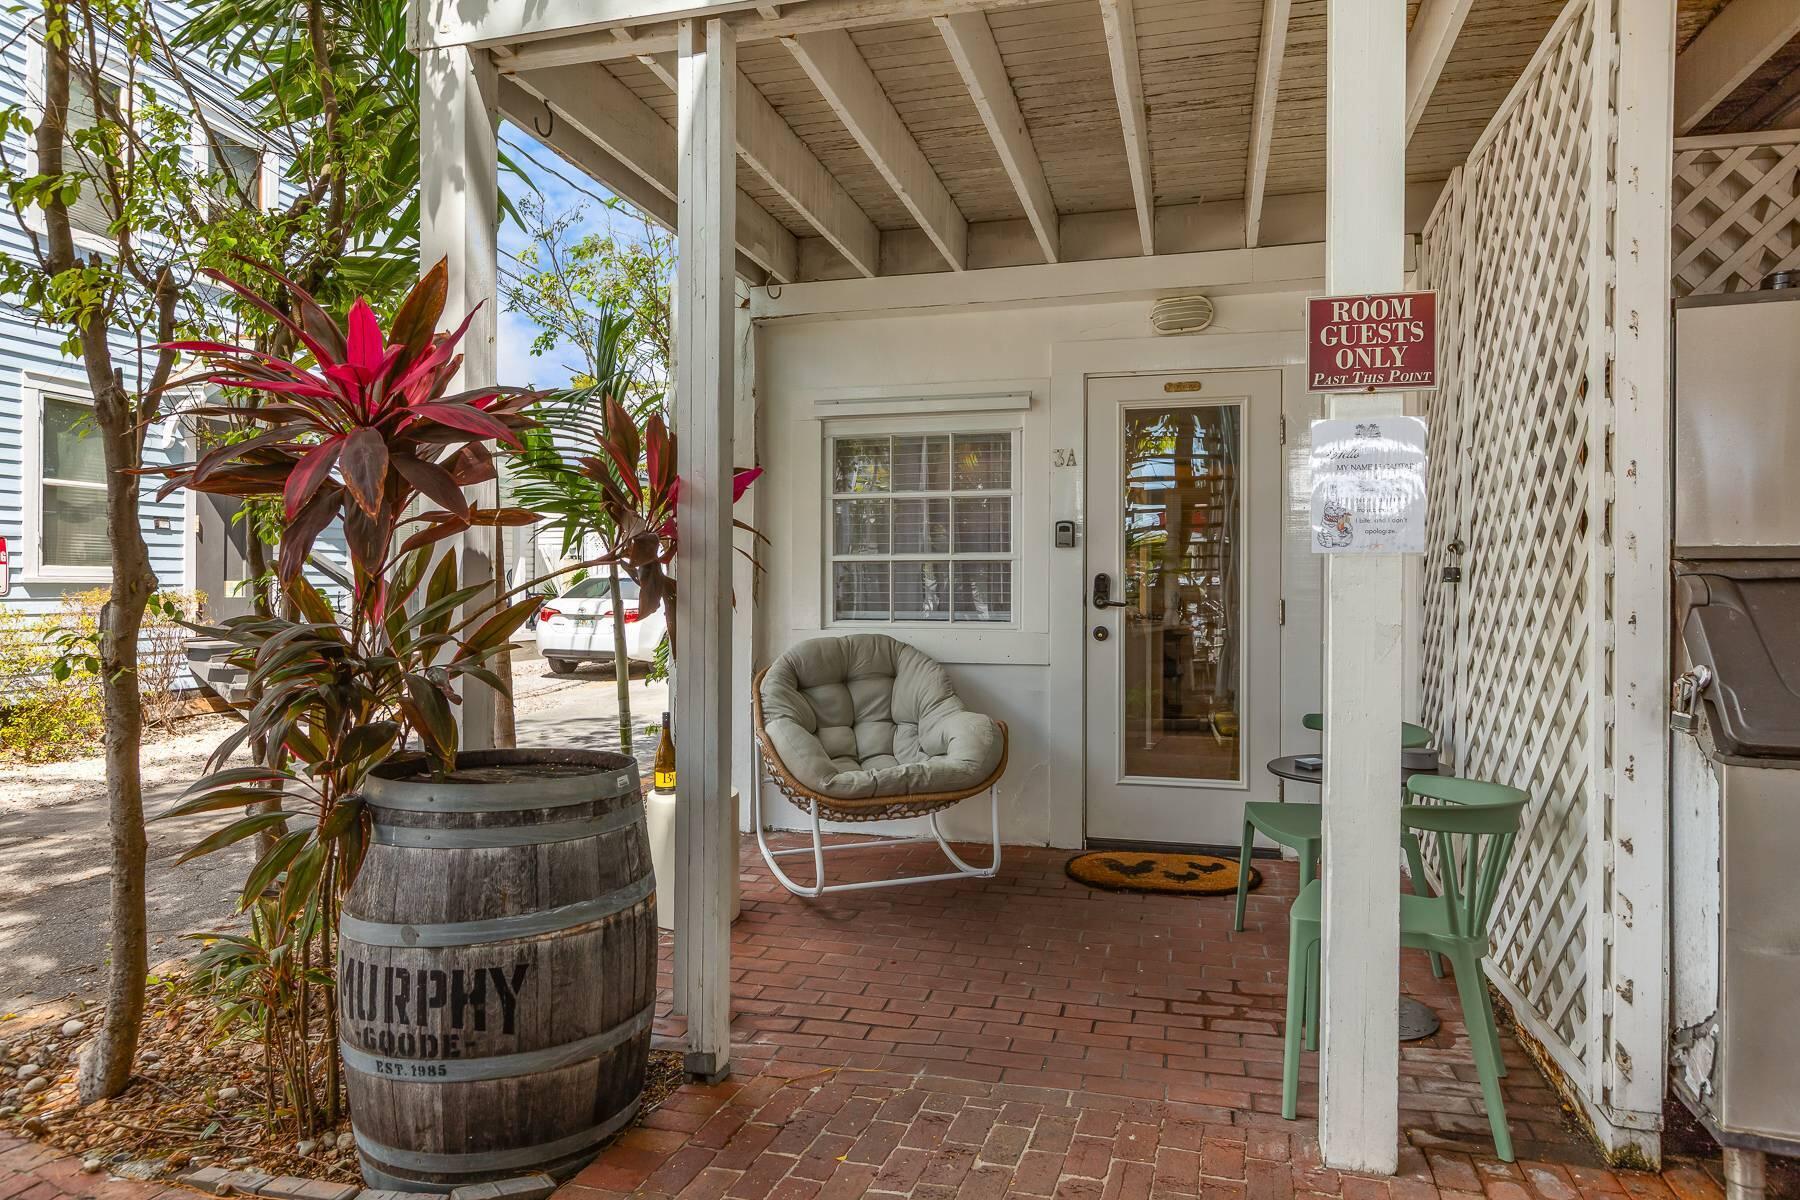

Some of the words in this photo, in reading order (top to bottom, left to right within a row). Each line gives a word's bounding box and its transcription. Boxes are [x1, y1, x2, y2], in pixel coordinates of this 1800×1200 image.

[1331, 298, 1414, 322] ROOM
[1320, 321, 1424, 346] GUESTS
[1335, 346, 1408, 369] ONLY
[1053, 448, 1077, 467] 3A
[1350, 463, 1373, 471] NAME
[341, 951, 530, 1035] MURPHY
